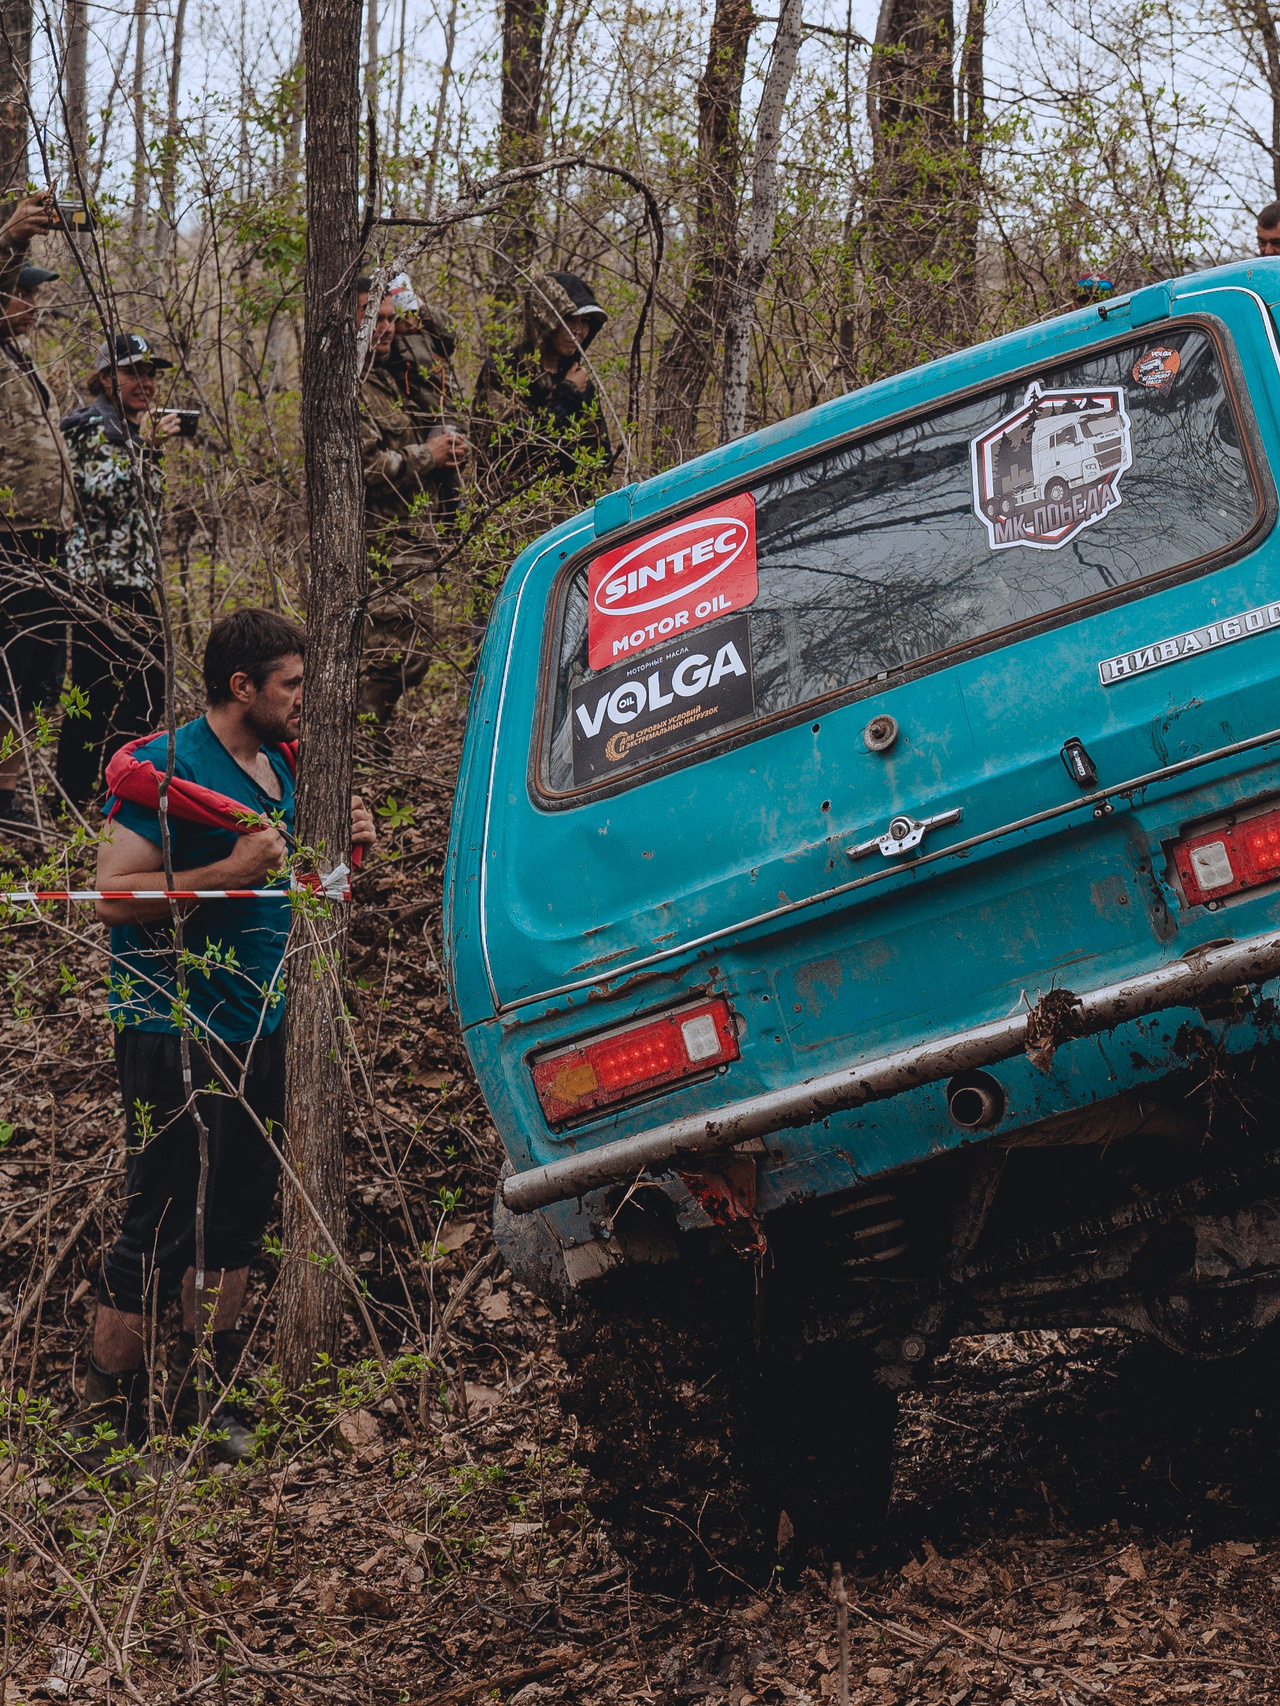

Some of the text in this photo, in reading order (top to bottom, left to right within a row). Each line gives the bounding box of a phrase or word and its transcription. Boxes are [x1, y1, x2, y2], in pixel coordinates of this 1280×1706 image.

[605, 528, 737, 604] SINTEC
[613, 594, 732, 656] MOTOR OIL
[626, 646, 690, 677] МОТОРНЫЕ МАСЛА
[1108, 633, 1201, 678] НИВА
[575, 641, 747, 738] VOLGA
[618, 696, 635, 709] OIL
[620, 704, 702, 745] ДЛЯ СУРОВЫХ УСЛОВИЙ
[625, 722, 683, 750] ЭКСТРЕМАЛЬНЫХ
[684, 706, 719, 725] НАГРУЗОК
